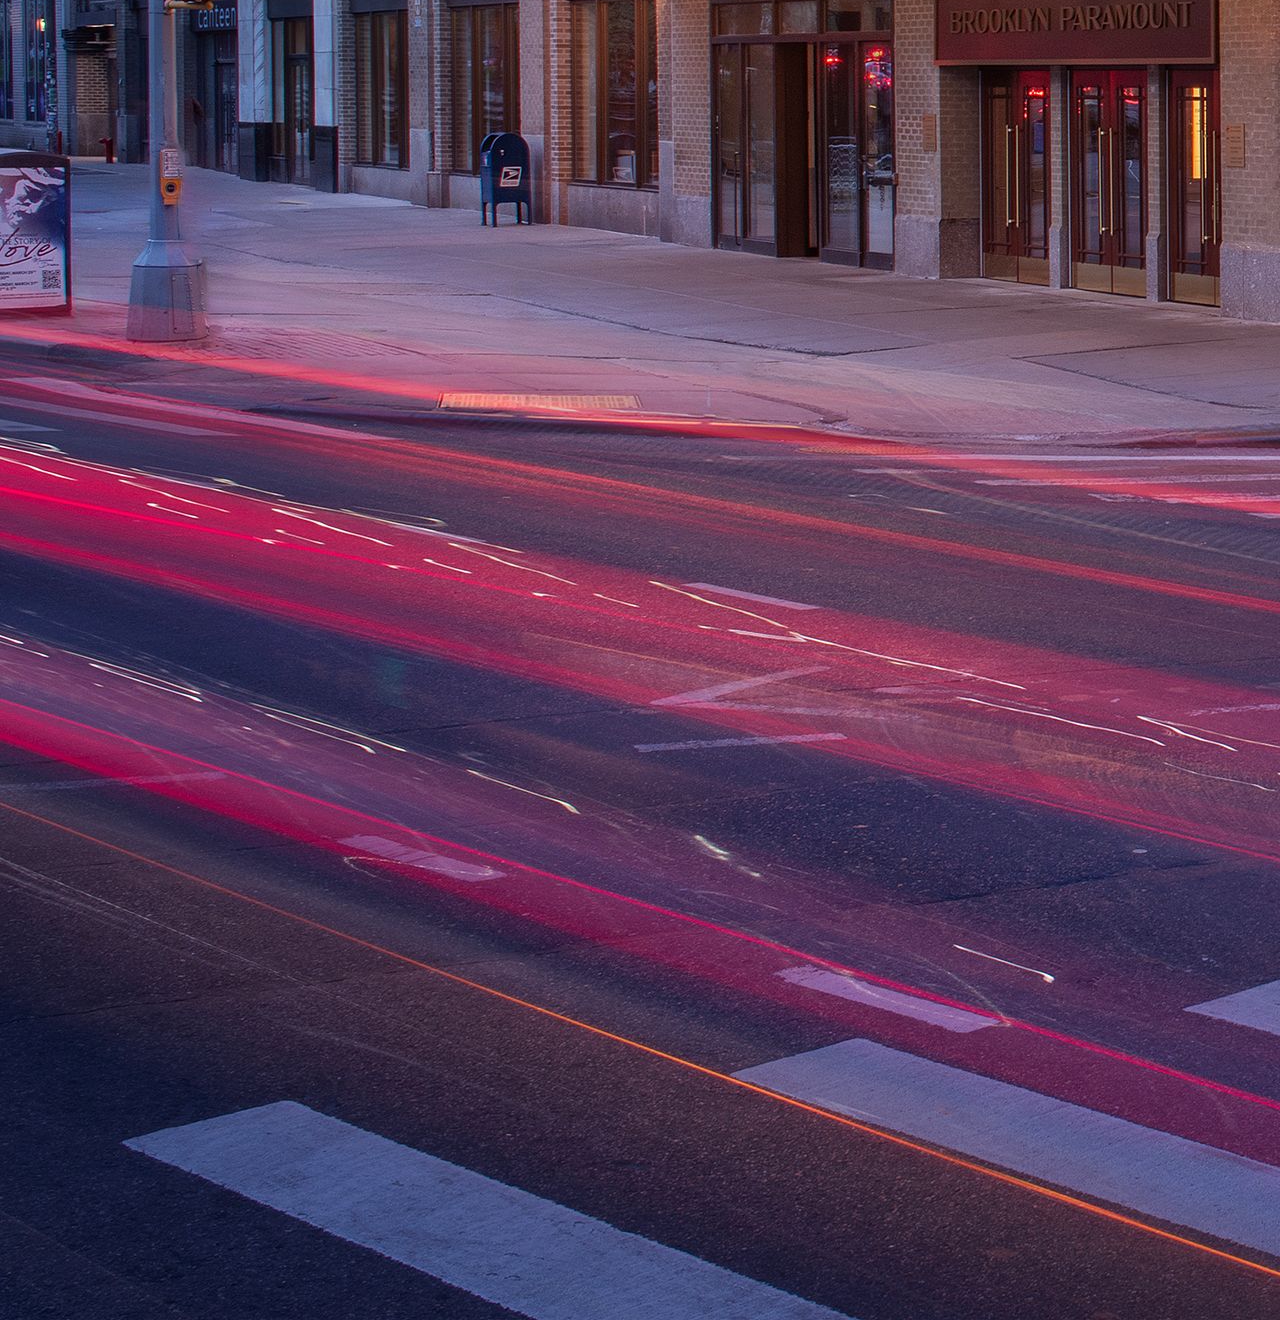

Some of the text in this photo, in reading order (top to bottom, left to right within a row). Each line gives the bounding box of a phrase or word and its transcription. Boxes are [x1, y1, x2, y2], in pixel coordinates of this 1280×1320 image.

[198, 5, 237, 28] canteen
[950, 0, 1194, 34] BROOKLYN PARAMOUNT
